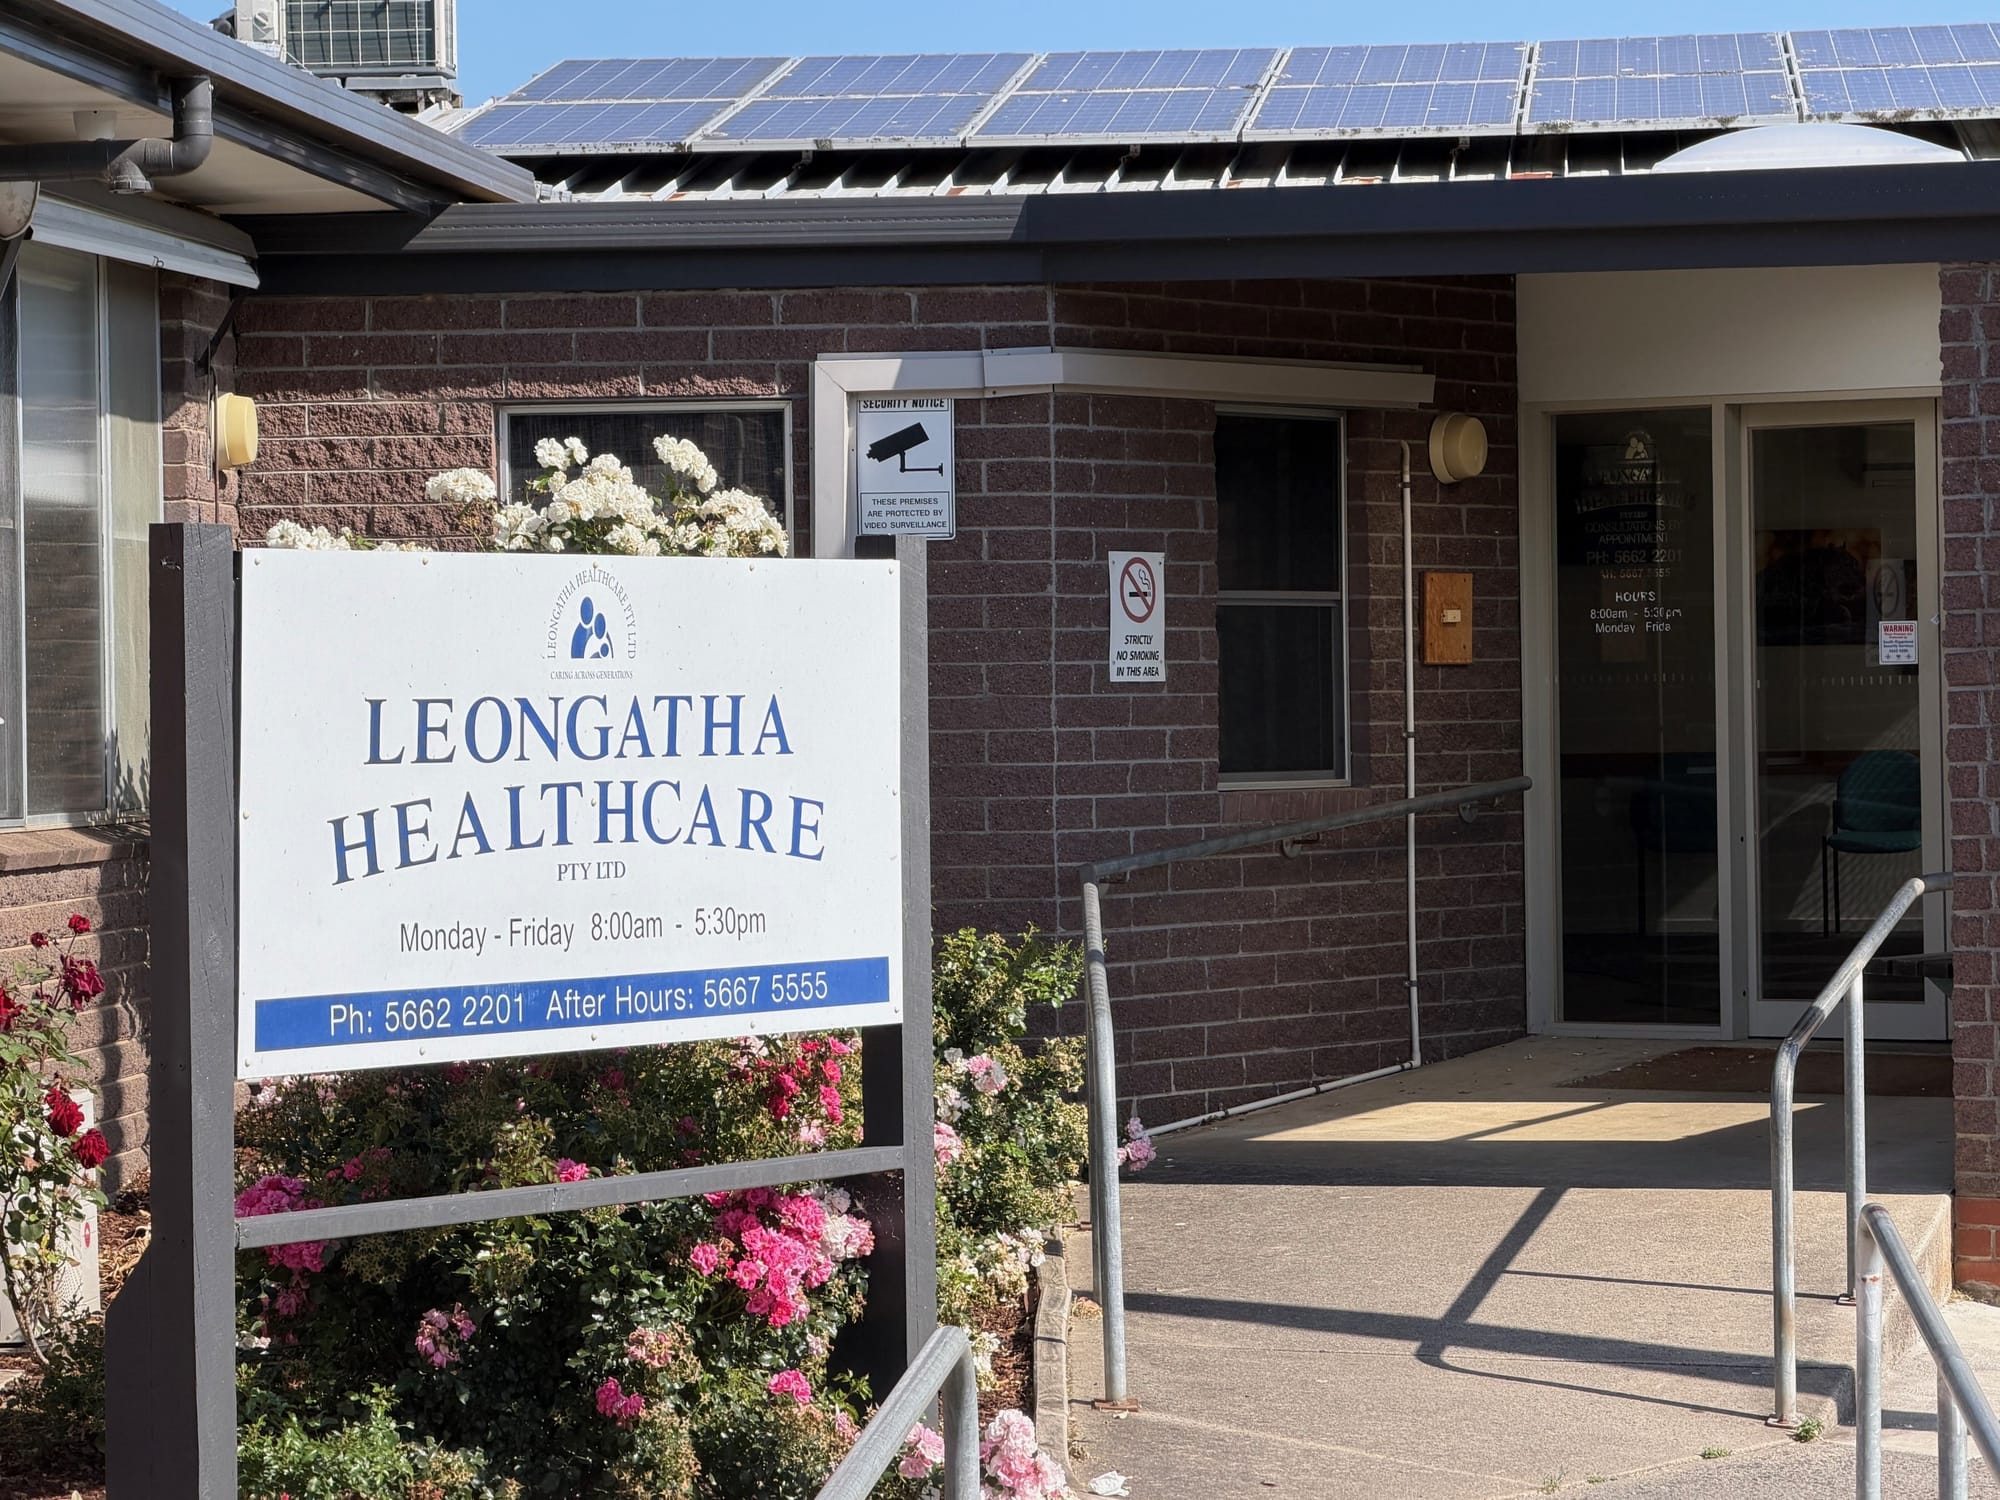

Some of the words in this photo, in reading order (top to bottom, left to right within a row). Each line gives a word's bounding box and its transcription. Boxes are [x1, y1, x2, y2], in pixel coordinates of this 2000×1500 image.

[862, 399, 909, 409] SECURITY
[911, 398, 945, 408] NOTICE
[872, 498, 897, 506] THESE
[900, 497, 939, 505] PREMISES
[867, 510, 883, 518] ARE
[886, 509, 930, 517] PROTECTED
[890, 520, 948, 529] SURVEILLANCE
[1614, 550, 1647, 564] 5662
[1652, 550, 1682, 563] 2201
[575, 567, 629, 606] HEALTHCARE
[1615, 590, 1656, 602] HOURS
[547, 579, 577, 659] LEONGATHA
[623, 603, 636, 628] PTY
[1590, 608, 1628, 620] 8:00am
[1595, 622, 1636, 634] Monday
[1646, 620, 1671, 632] Frida
[1883, 624, 1913, 632] WARNING
[627, 631, 637, 660] LTD
[1124, 634, 1153, 645] STRICTLY
[1116, 650, 1128, 661] NO
[1129, 650, 1160, 661] SMOKING
[550, 671, 574, 680] CARING
[574, 671, 596, 680] ACROSS
[596, 670, 633, 680] GENERATIONS
[1116, 666, 1124, 677] IN
[1126, 666, 1142, 677] THIS
[1142, 666, 1160, 677] AREA
[363, 694, 794, 765] LEONGATHA
[327, 780, 826, 886] HEALTHCARE
[557, 862, 592, 881] PTY
[596, 860, 626, 879] LTD
[400, 920, 487, 956] Monday
[509, 917, 575, 952] Friday
[591, 911, 663, 941] 8:00am
[695, 906, 766, 940] 5:30pm
[330, 1003, 373, 1037] Ph:
[385, 997, 451, 1032] 5662
[463, 993, 523, 1026] 2201
[546, 988, 606, 1020] After
[616, 984, 694, 1015] Hours:
[704, 976, 761, 1008] 5667
[771, 971, 828, 1003] 5555
